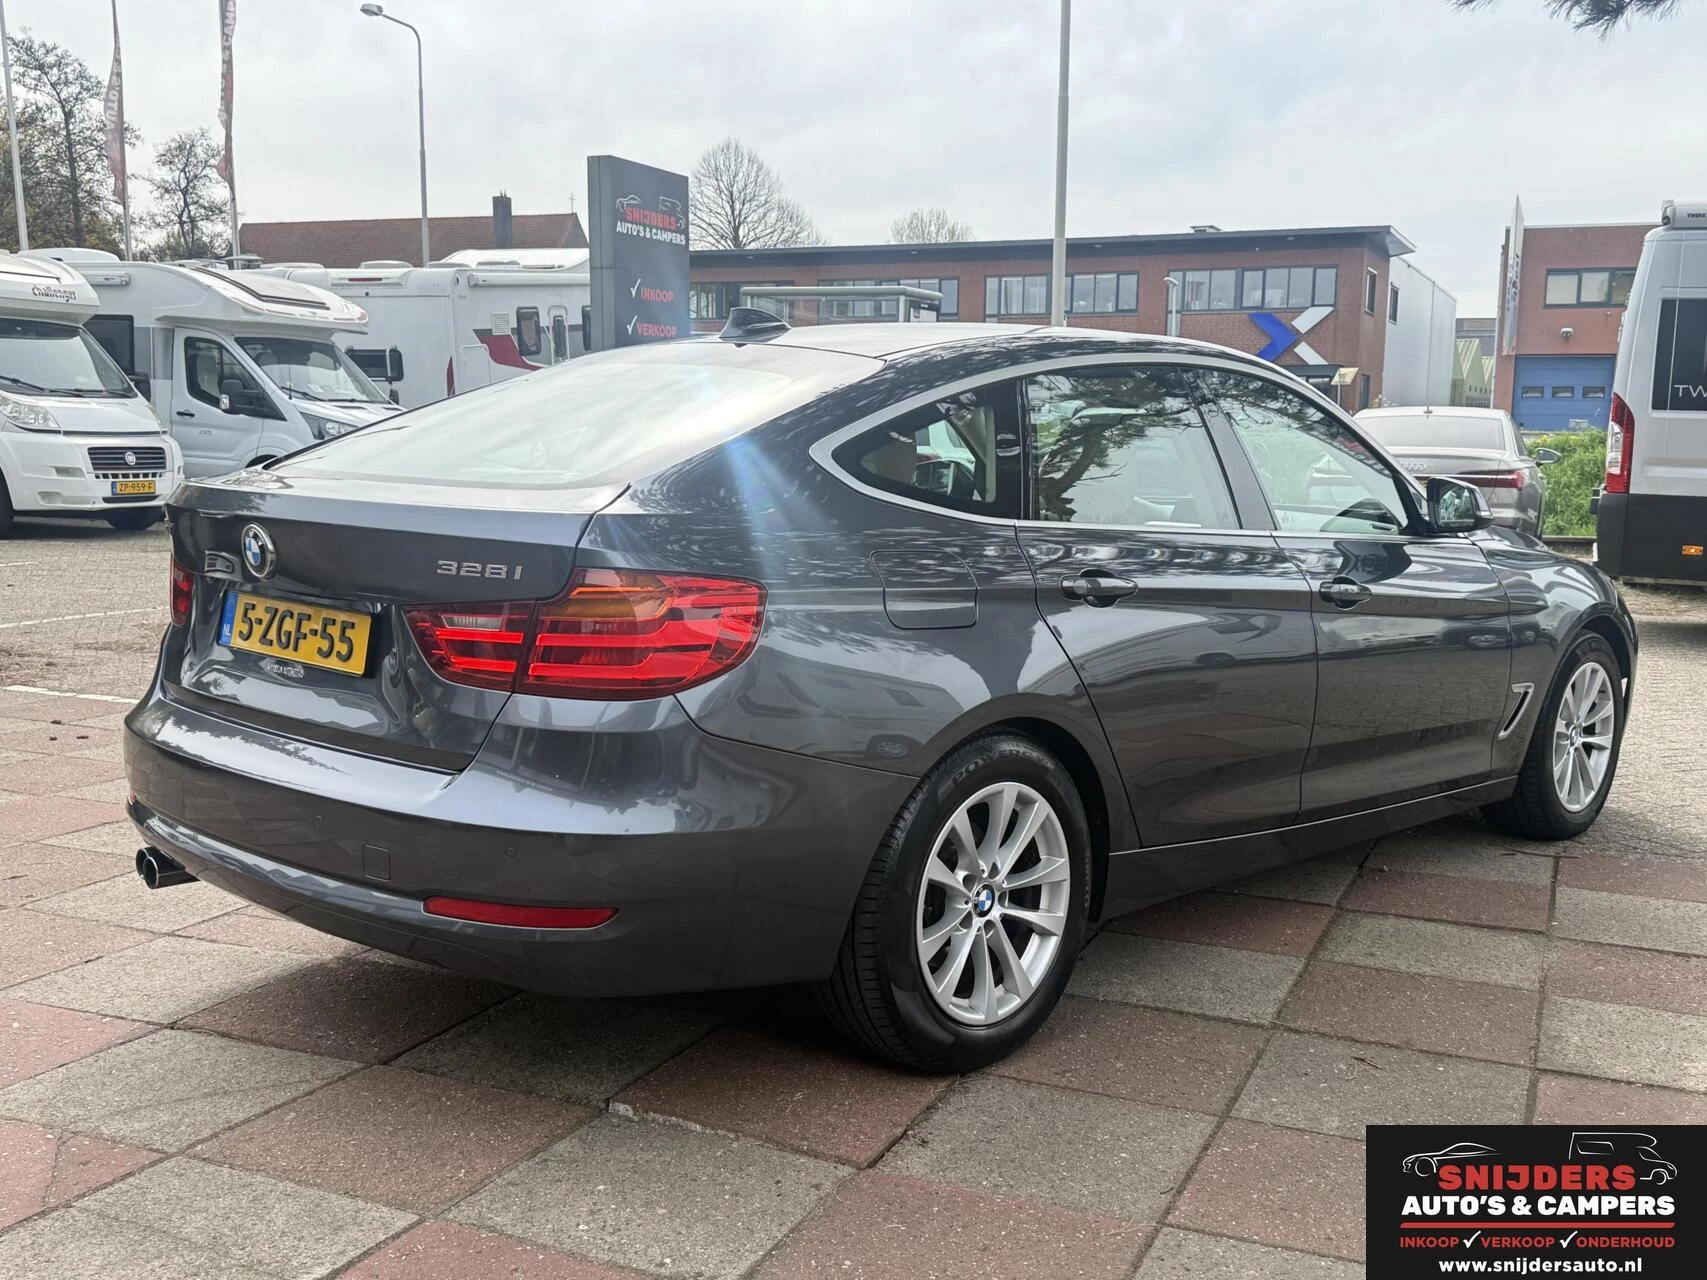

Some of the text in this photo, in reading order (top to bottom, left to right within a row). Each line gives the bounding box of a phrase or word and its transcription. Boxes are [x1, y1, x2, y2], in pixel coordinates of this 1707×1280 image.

[626, 207, 677, 229] SNIJDERS
[616, 221, 686, 246] AUTO'S & CAMPERS
[640, 287, 674, 302] INKOOP
[636, 323, 677, 338] VERKOOP
[119, 482, 153, 493] ZP-959-F
[238, 601, 356, 663] 5-ZGF-55
